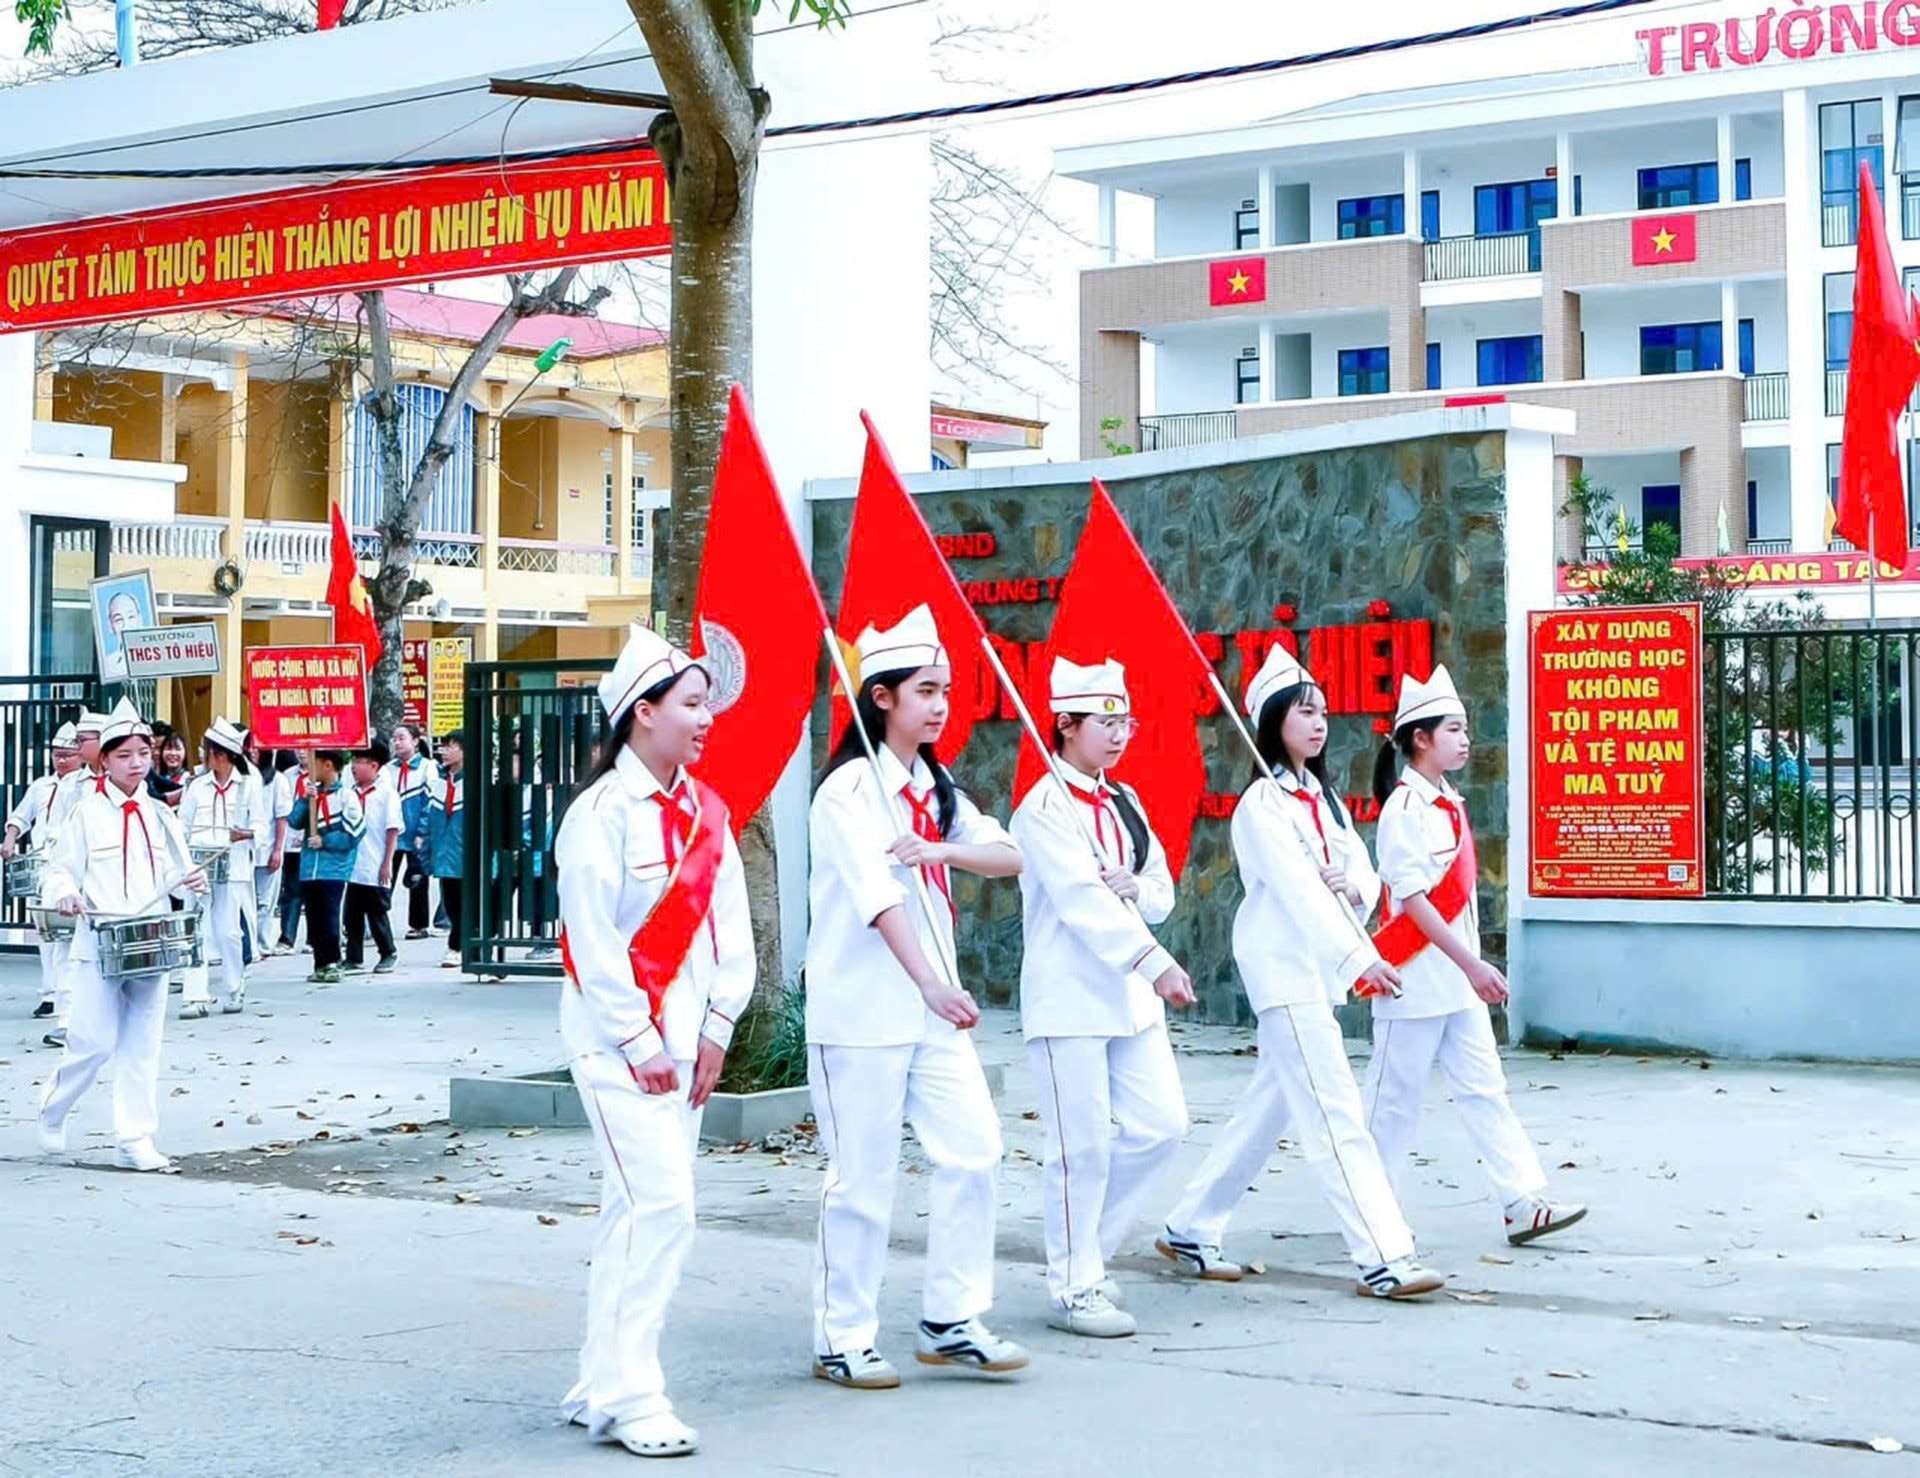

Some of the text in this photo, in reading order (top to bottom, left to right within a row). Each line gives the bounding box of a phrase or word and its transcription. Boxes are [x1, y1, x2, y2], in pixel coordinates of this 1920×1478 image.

[1635, 0, 1920, 76] TRƯỜNG
[7, 245, 78, 312] QUYẾT
[85, 243, 137, 298] TÂM
[144, 235, 207, 297] THỰC
[214, 222, 275, 289] HIỆN
[283, 204, 370, 274] THẮNG
[378, 204, 421, 268] LỢI
[430, 188, 524, 257] NHIỆM
[534, 187, 572, 249] VỤ
[581, 170, 654, 234] NĂM
[935, 531, 997, 558] BND
[1556, 619, 1671, 643] XÂY DỰNG
[128, 640, 214, 662] THCS TÔ HIỆU
[1541, 649, 1686, 671] TRƯỜNG HỌC
[251, 655, 278, 678] NƯỚC
[279, 656, 304, 681] CỘNG
[326, 655, 341, 677] XÃ
[341, 655, 359, 680] HỘI
[259, 681, 355, 710] CHỦ NGHĨA VIỆT NAM
[1567, 674, 1660, 700] KHÔNG
[279, 713, 307, 735] MUÔN
[308, 713, 332, 735] NĂM
[1549, 706, 1679, 736] TỘI PHẠM
[1544, 738, 1684, 767] VÀ TỆ NẠN
[1564, 767, 1665, 795] MA TUÝ
